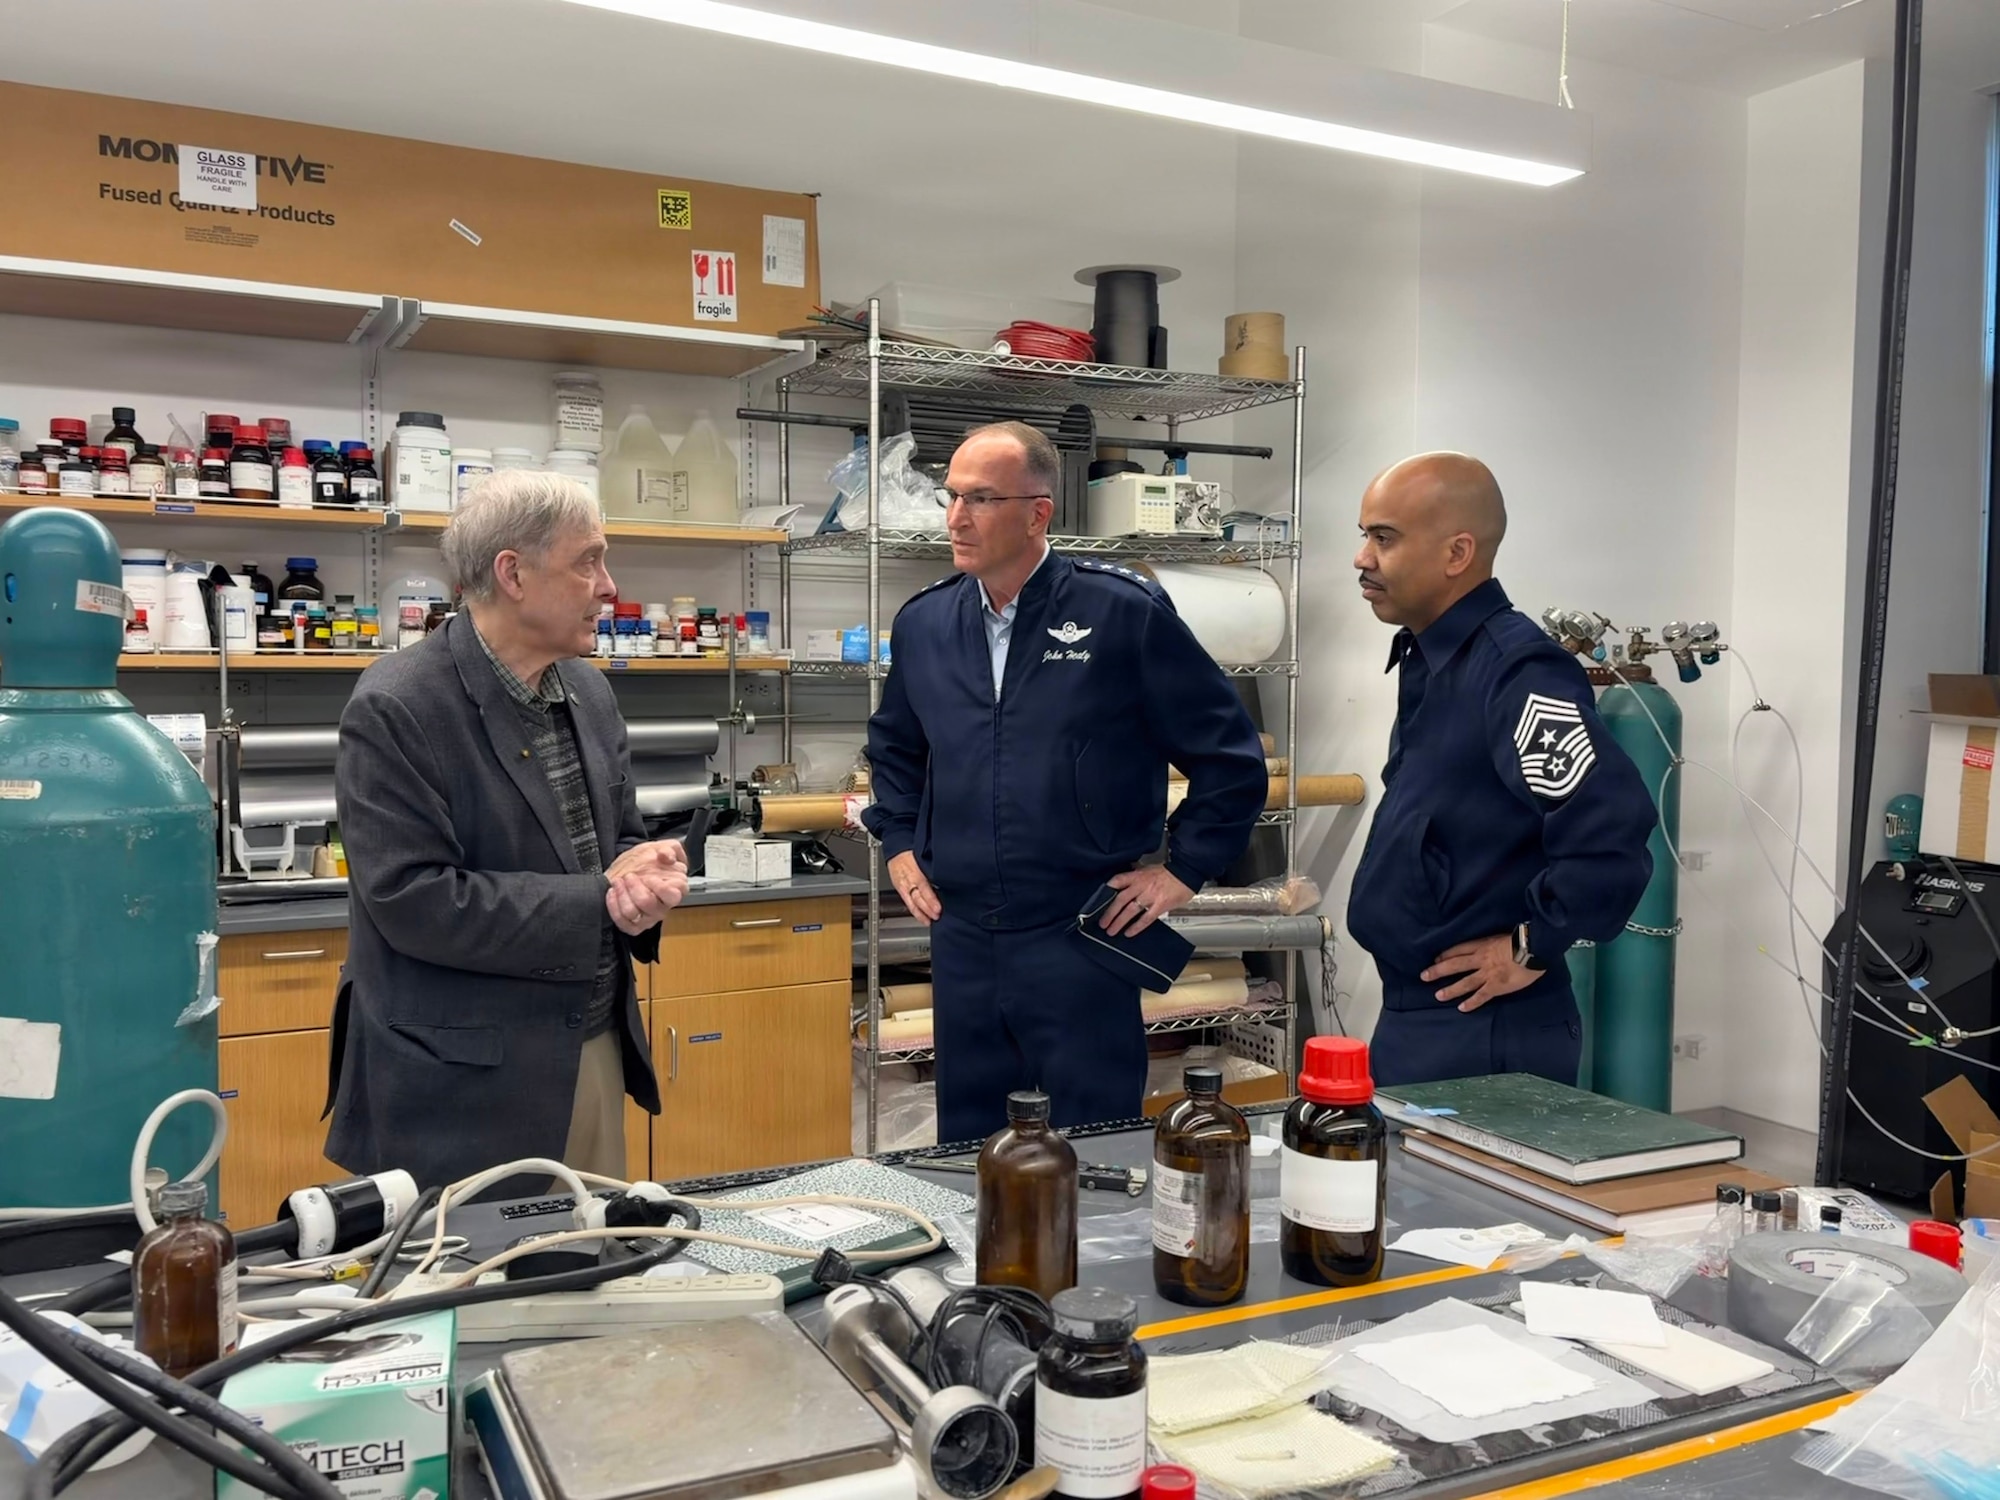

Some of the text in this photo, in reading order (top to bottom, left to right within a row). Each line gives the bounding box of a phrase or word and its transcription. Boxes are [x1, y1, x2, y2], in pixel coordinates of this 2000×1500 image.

[197, 151, 246, 168] GLASS
[200, 166, 243, 178] FRAGILE
[196, 175, 247, 187] HANDLE WITH
[211, 184, 232, 193] CARE
[99, 182, 162, 206] Fused
[698, 300, 732, 318] fragile
[1914, 873, 1986, 893] HASKIS
[323, 1368, 442, 1390] KIMTECH
